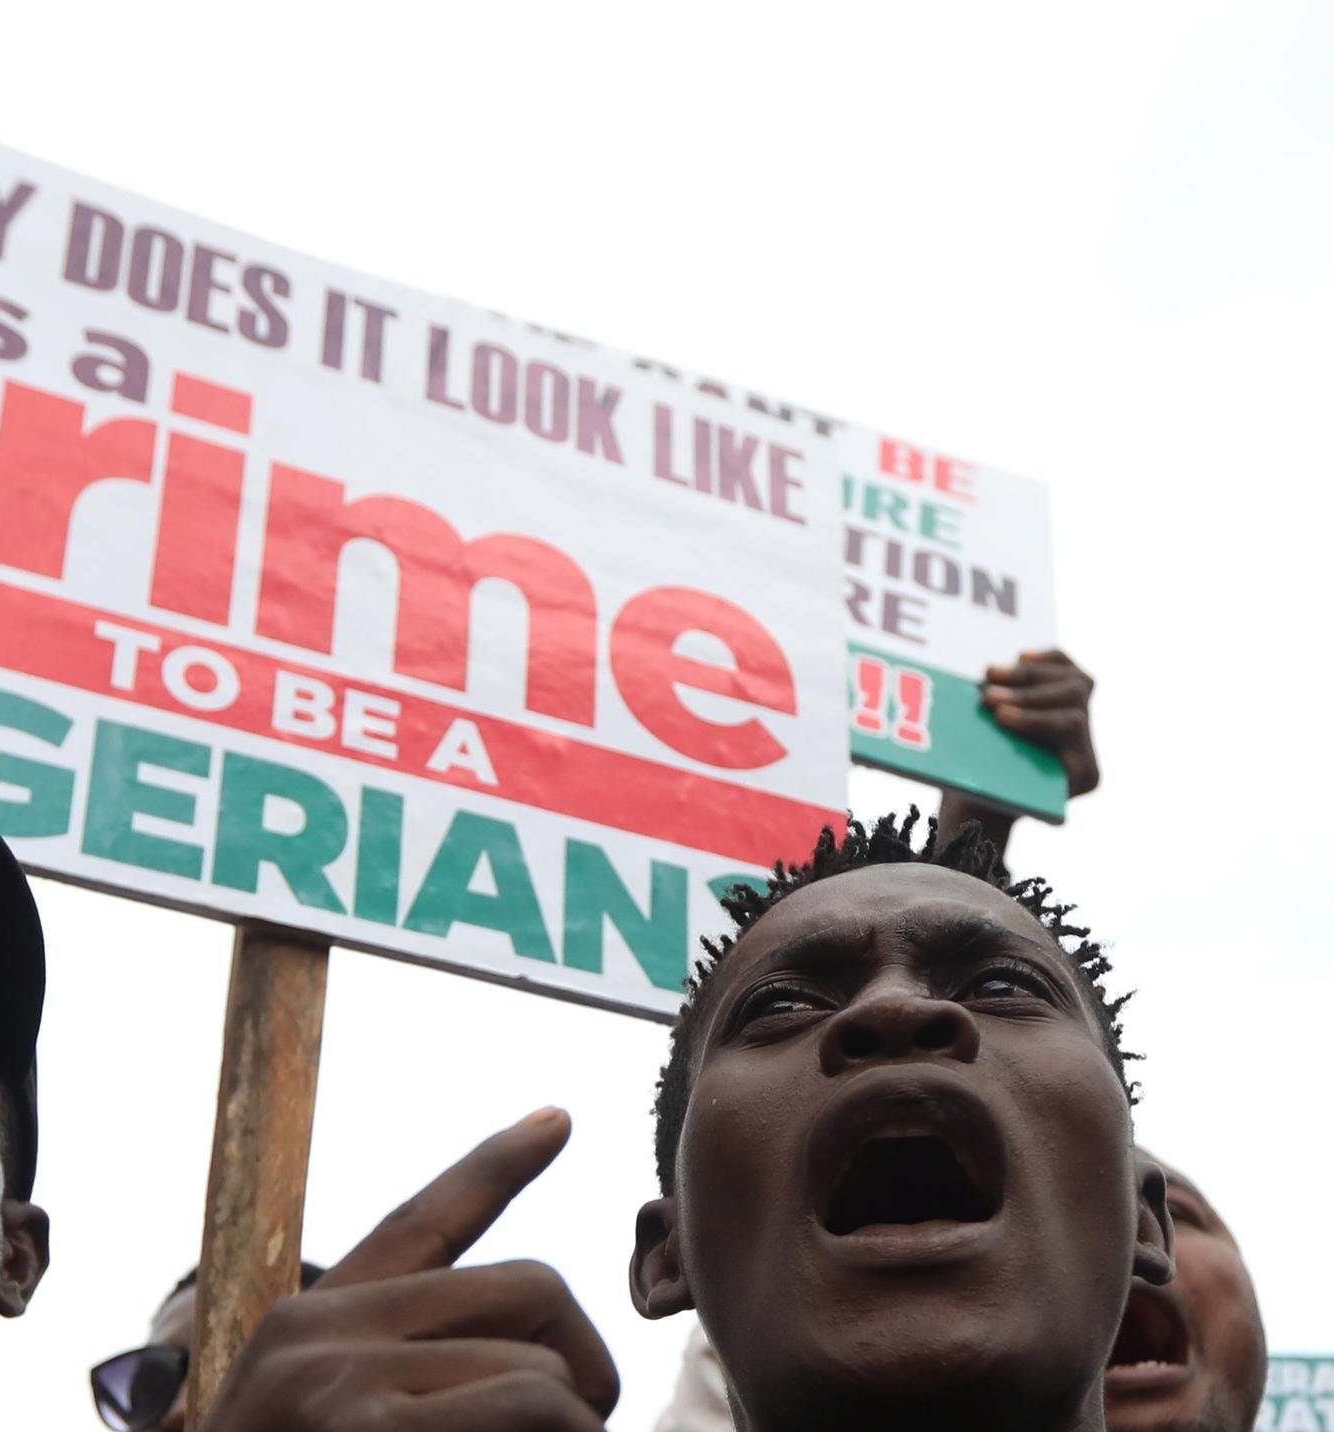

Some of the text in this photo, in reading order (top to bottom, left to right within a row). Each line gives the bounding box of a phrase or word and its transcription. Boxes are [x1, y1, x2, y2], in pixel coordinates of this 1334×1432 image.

[62, 198, 292, 351] DOES
[318, 284, 399, 385] IT
[424, 321, 626, 468] LOOK
[651, 398, 808, 527] LIKE
[69, 326, 151, 405] a
[93, 620, 500, 788] TO BE A
